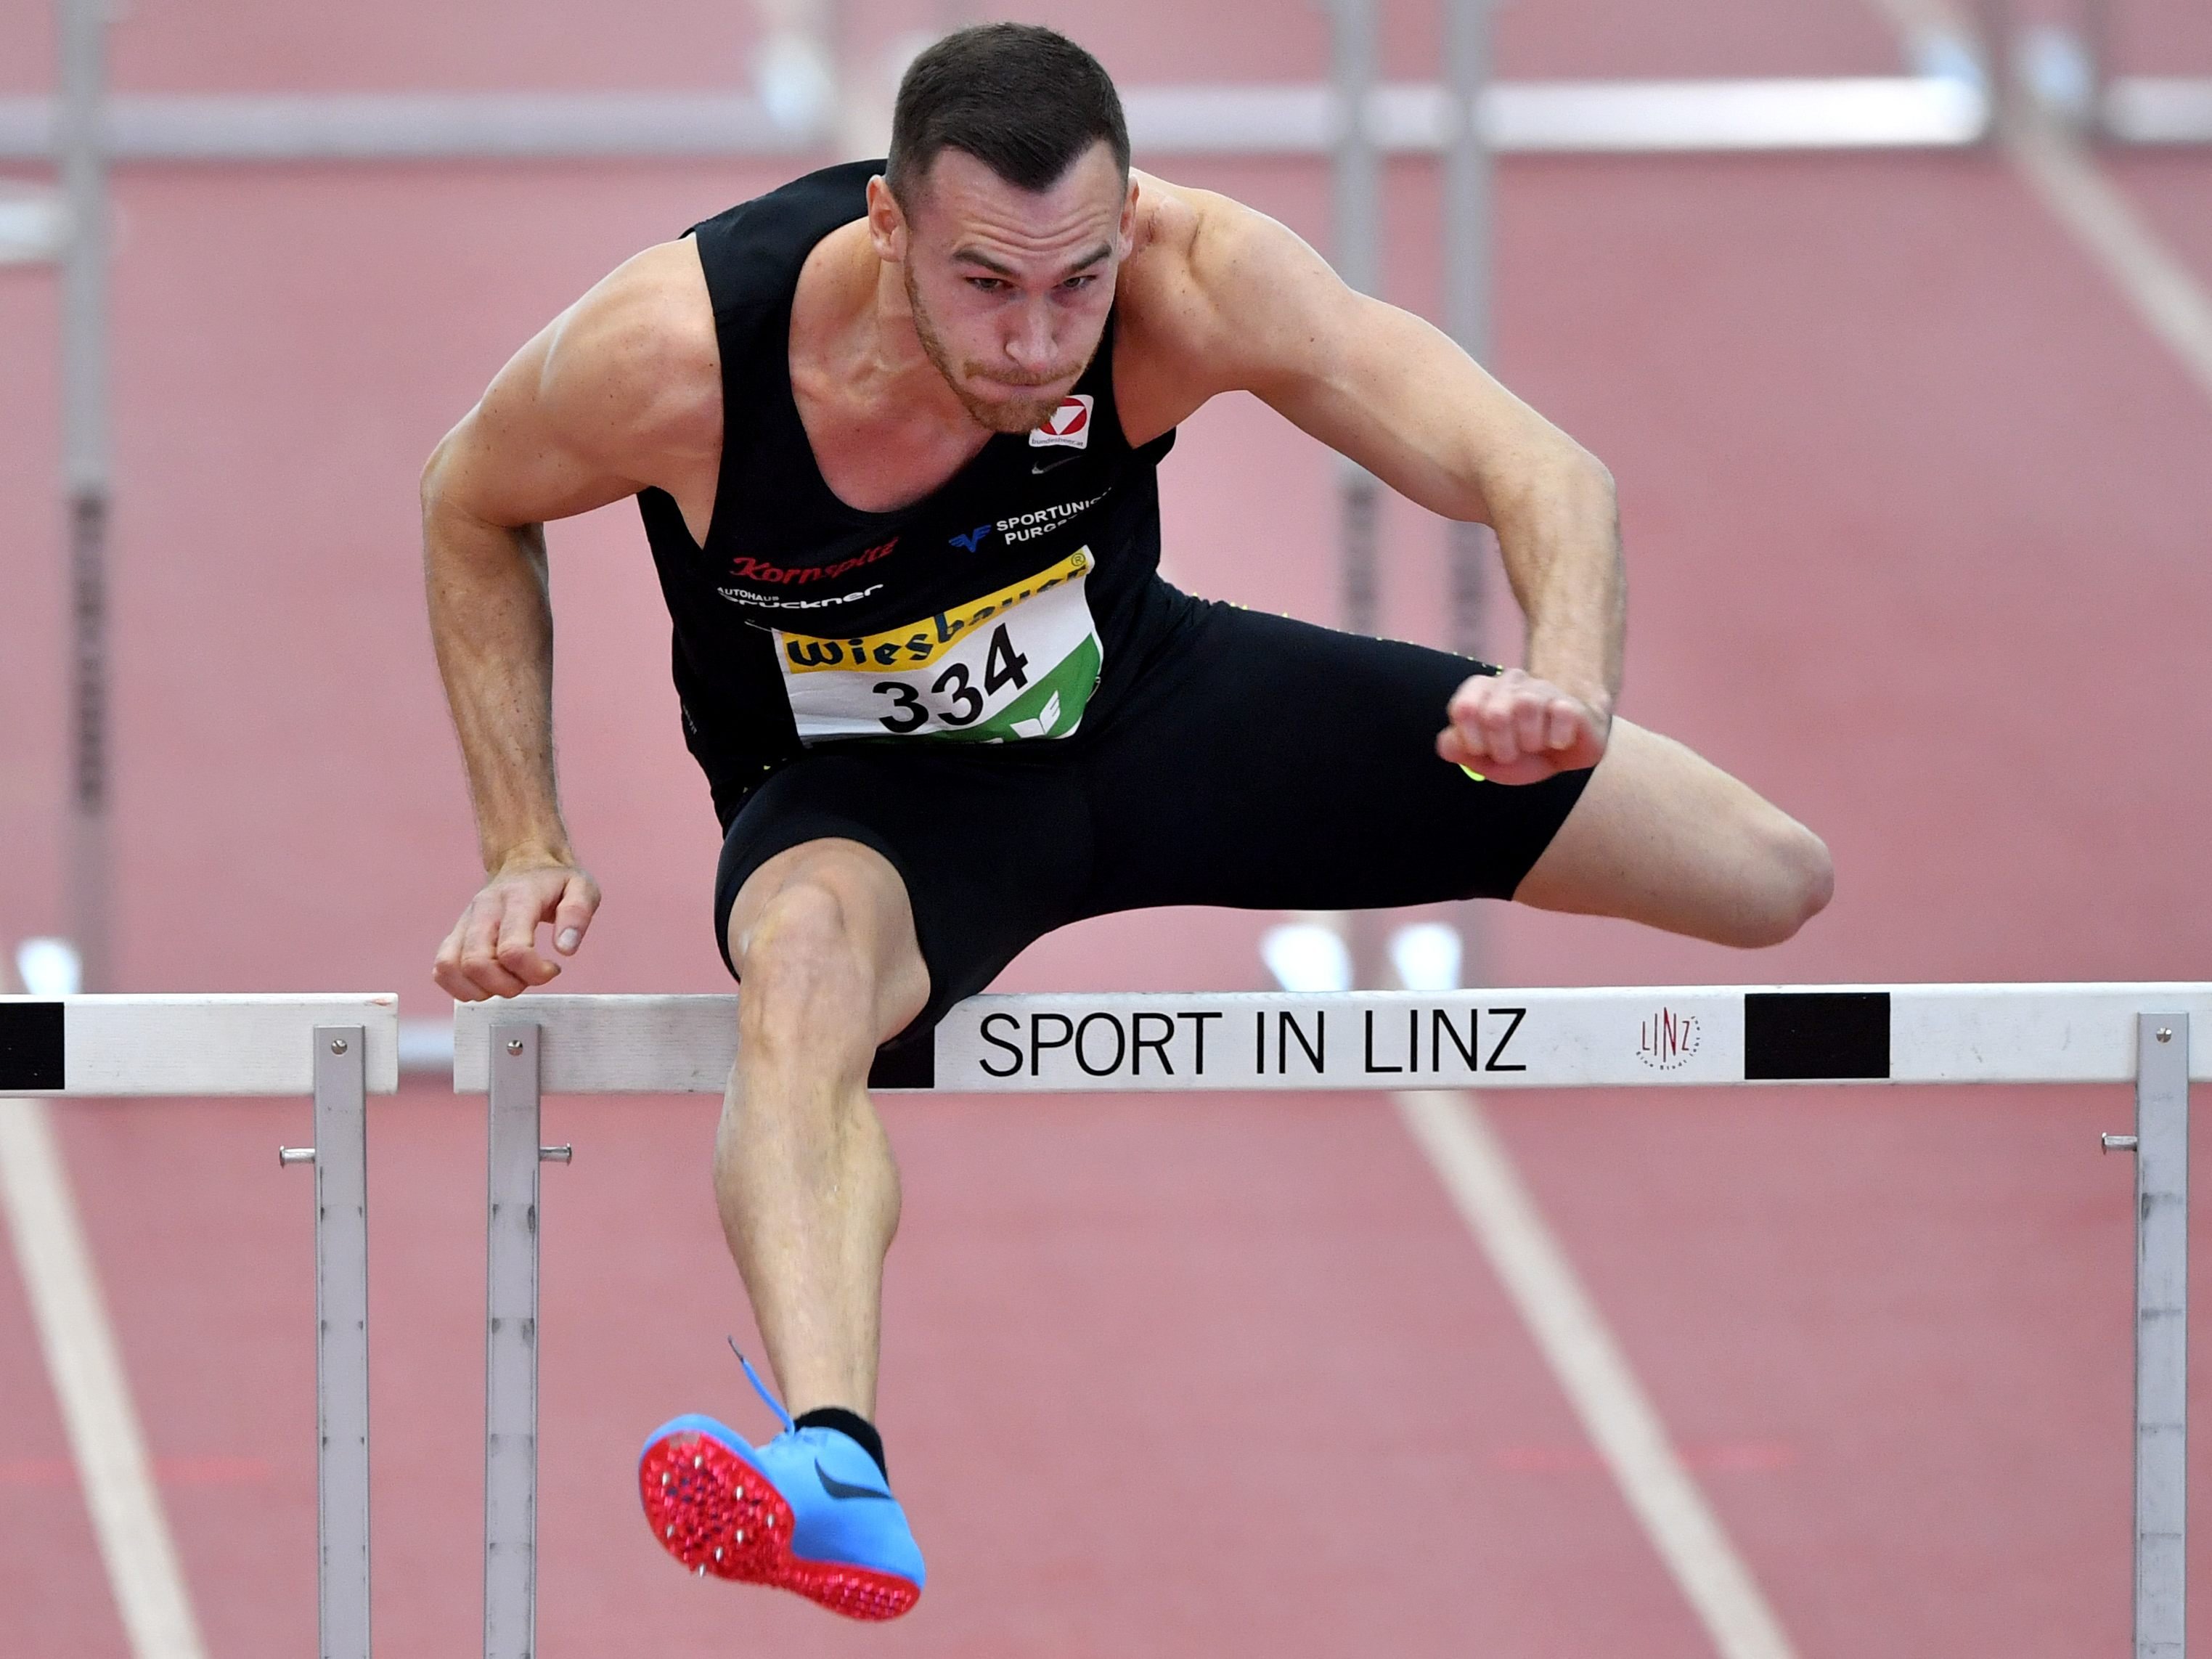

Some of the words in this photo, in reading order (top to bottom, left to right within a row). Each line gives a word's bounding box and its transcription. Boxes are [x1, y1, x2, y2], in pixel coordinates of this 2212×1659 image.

[1032, 437, 1084, 447] bundesheer.at
[996, 486, 1112, 531] SPORTUNI
[730, 536, 899, 584] Kornspitz
[717, 587, 780, 602] AUTOHAUS
[873, 622, 1029, 734] 334
[979, 1012, 1223, 1077] SPORT
[1256, 1011, 1325, 1076] IN
[1365, 1008, 1527, 1075] LINZ
[1642, 1006, 1690, 1063] LINZ
